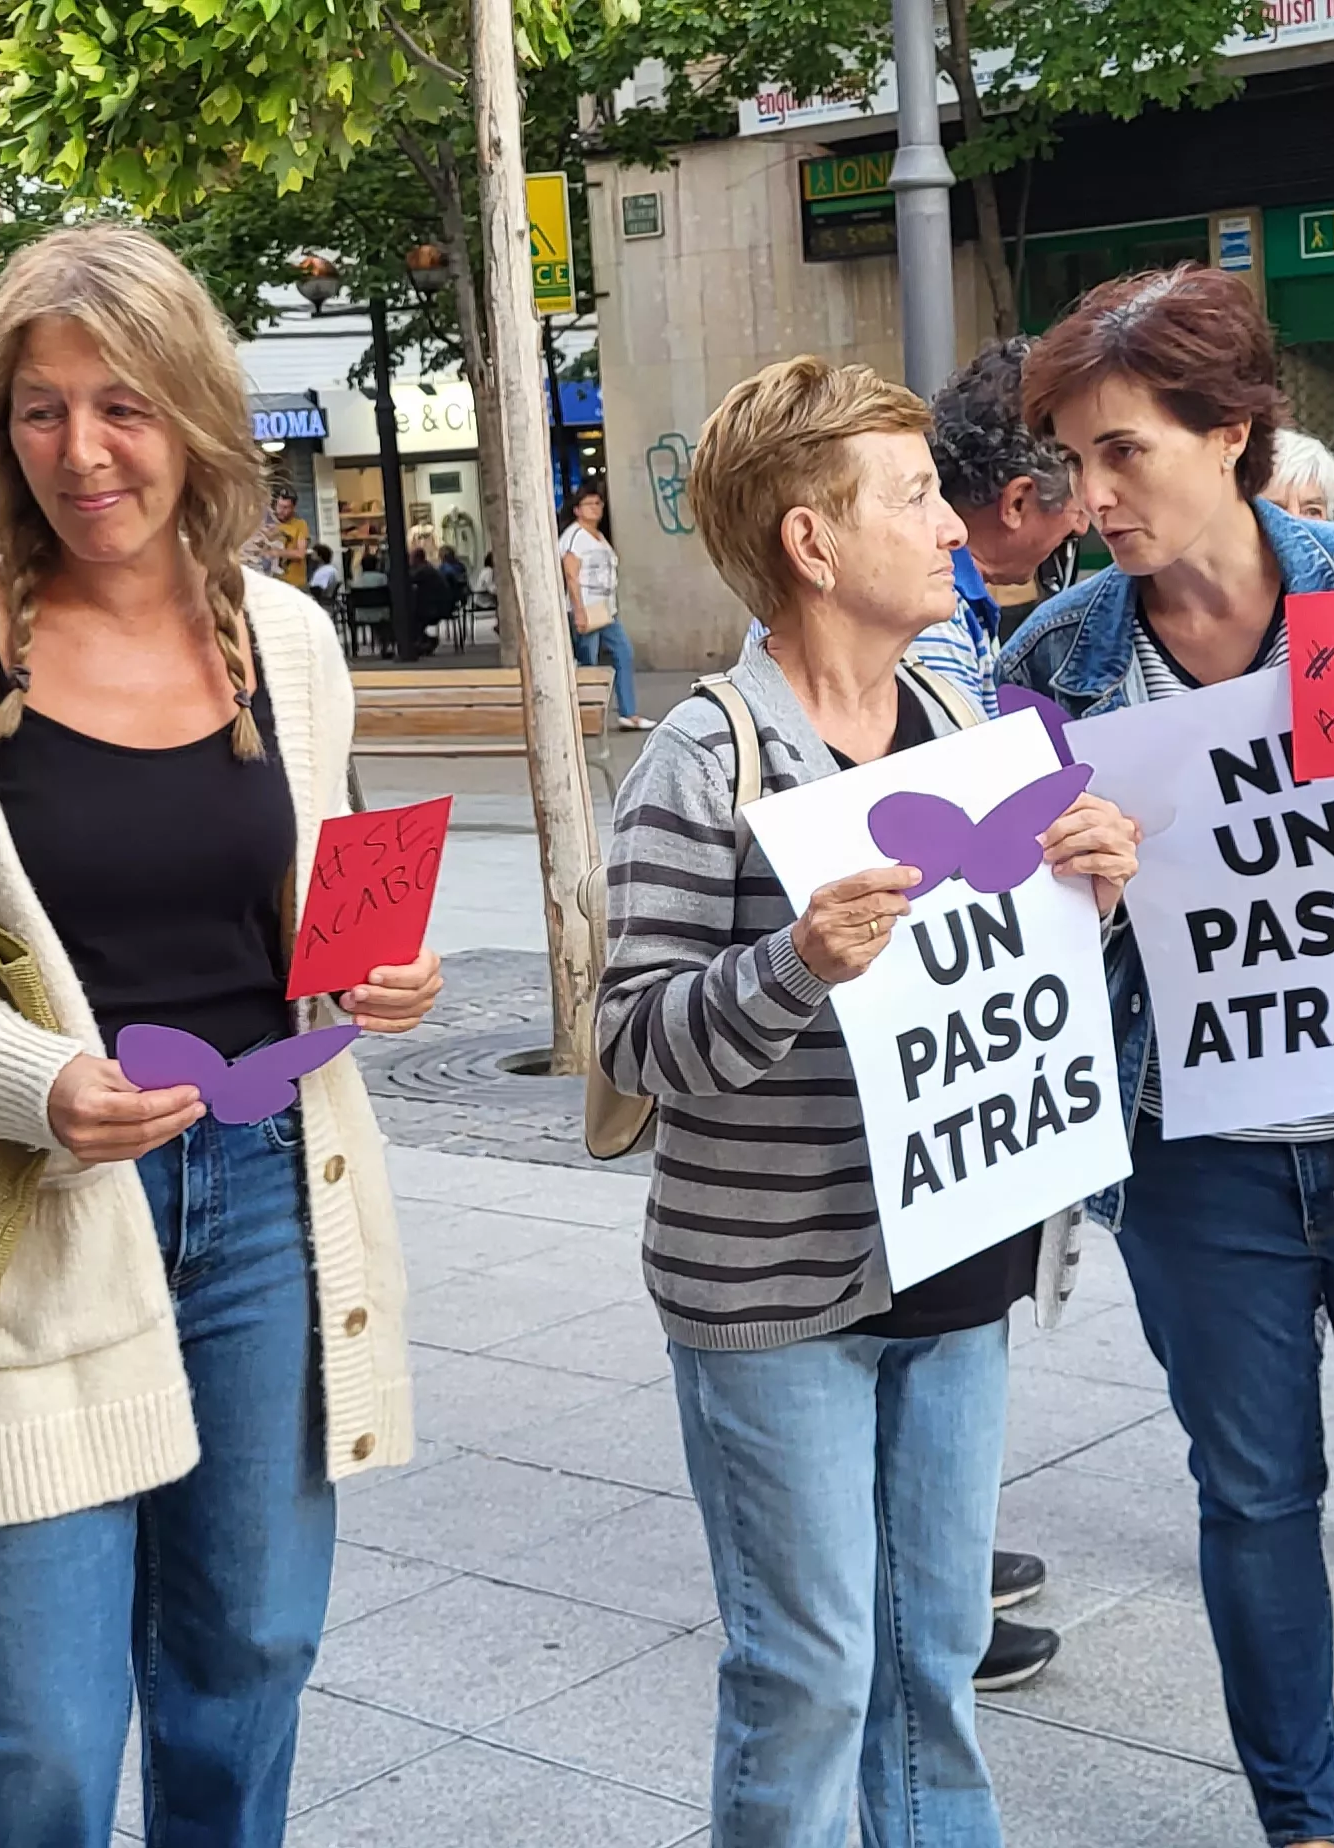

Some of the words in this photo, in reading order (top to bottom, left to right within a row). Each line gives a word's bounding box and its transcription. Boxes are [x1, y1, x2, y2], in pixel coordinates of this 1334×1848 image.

[839, 156, 886, 189] ON
[535, 264, 569, 284] CE
[421, 404, 440, 432] &
[304, 836, 439, 960] ACABÓ
[910, 890, 1025, 986] UN
[895, 973, 1069, 1103] PASO
[900, 1053, 1101, 1210] ATRÁS
